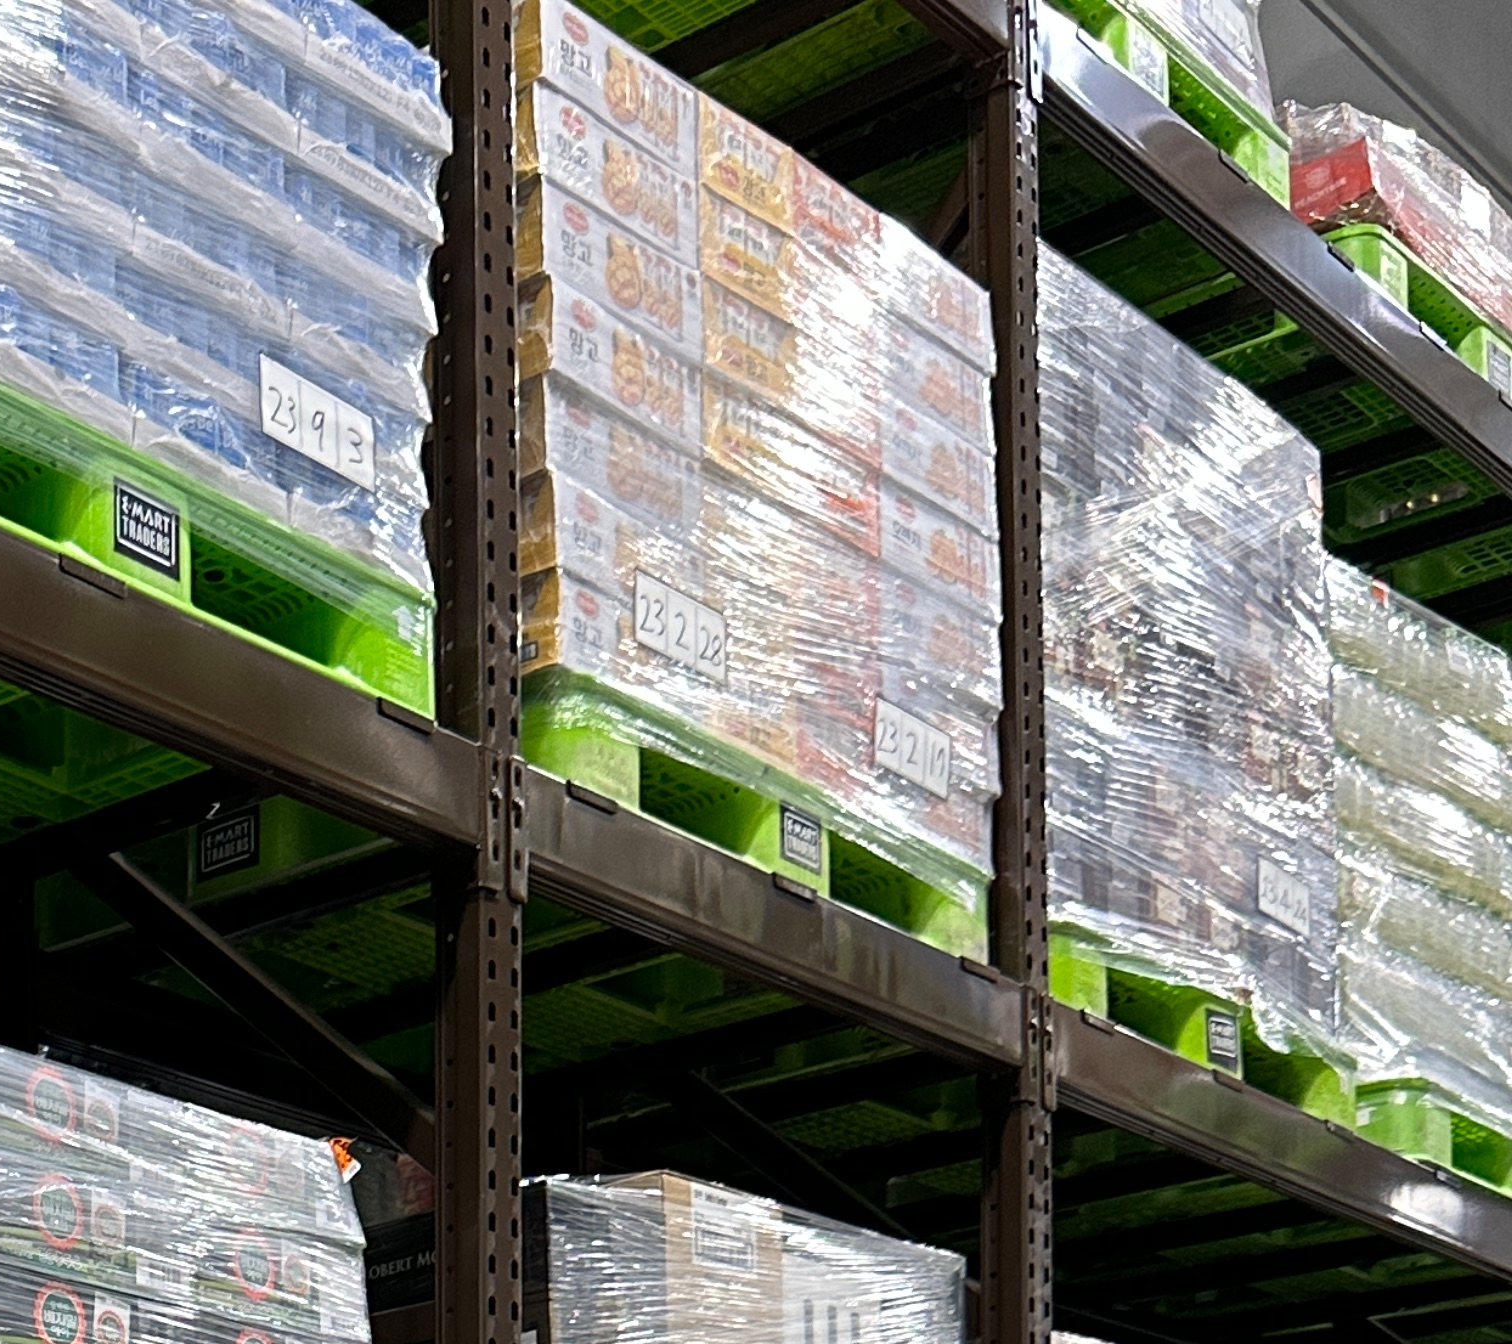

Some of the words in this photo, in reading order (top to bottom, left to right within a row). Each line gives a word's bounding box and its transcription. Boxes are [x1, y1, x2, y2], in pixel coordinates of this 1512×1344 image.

[268, 387, 297, 434] 23
[311, 410, 325, 452] 9
[347, 428, 364, 464] 3
[121, 517, 171, 556] TRADERS
[639, 594, 665, 636] 23
[699, 626, 723, 667] 28
[368, 1256, 412, 1281] OBERT
